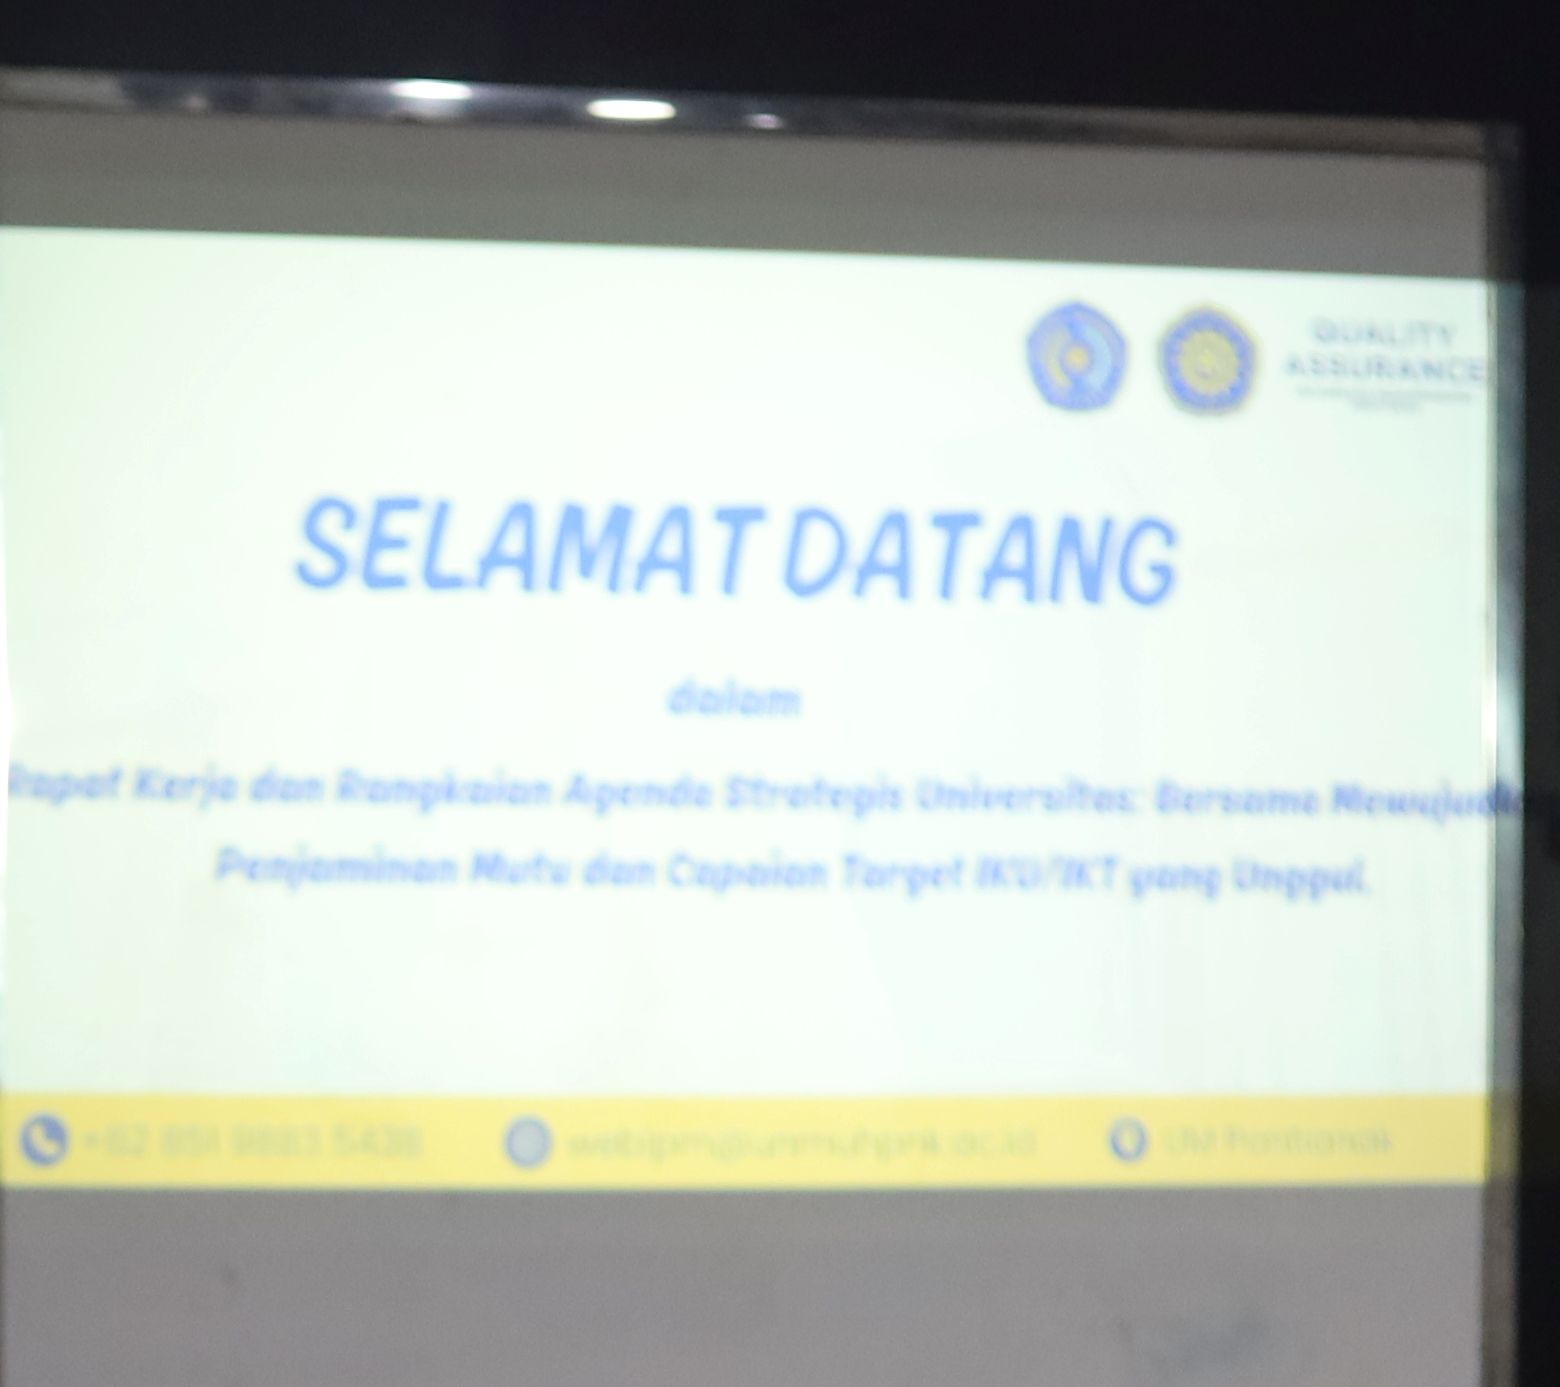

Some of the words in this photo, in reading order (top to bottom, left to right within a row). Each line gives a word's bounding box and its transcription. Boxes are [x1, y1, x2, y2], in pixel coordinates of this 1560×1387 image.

[1310, 317, 1457, 347] QUALITY
[1282, 353, 1486, 384] ASSURANCE
[294, 494, 768, 597] SELAMAT
[782, 506, 1178, 608] DATANG
[665, 677, 803, 720] dalam
[8, 762, 123, 807] Rapat
[132, 766, 239, 811] Kerja
[247, 766, 325, 804] dan
[334, 767, 553, 816] Rangkaian
[561, 771, 713, 819] Agenda
[724, 772, 904, 821] Strategis
[1152, 778, 1321, 817] Bersama
[213, 844, 460, 892] Penjaminan
[467, 849, 572, 887] Mutu
[580, 850, 656, 887] dan
[665, 850, 829, 896] Capaian
[841, 851, 966, 901] Target
[1127, 862, 1223, 903] yang
